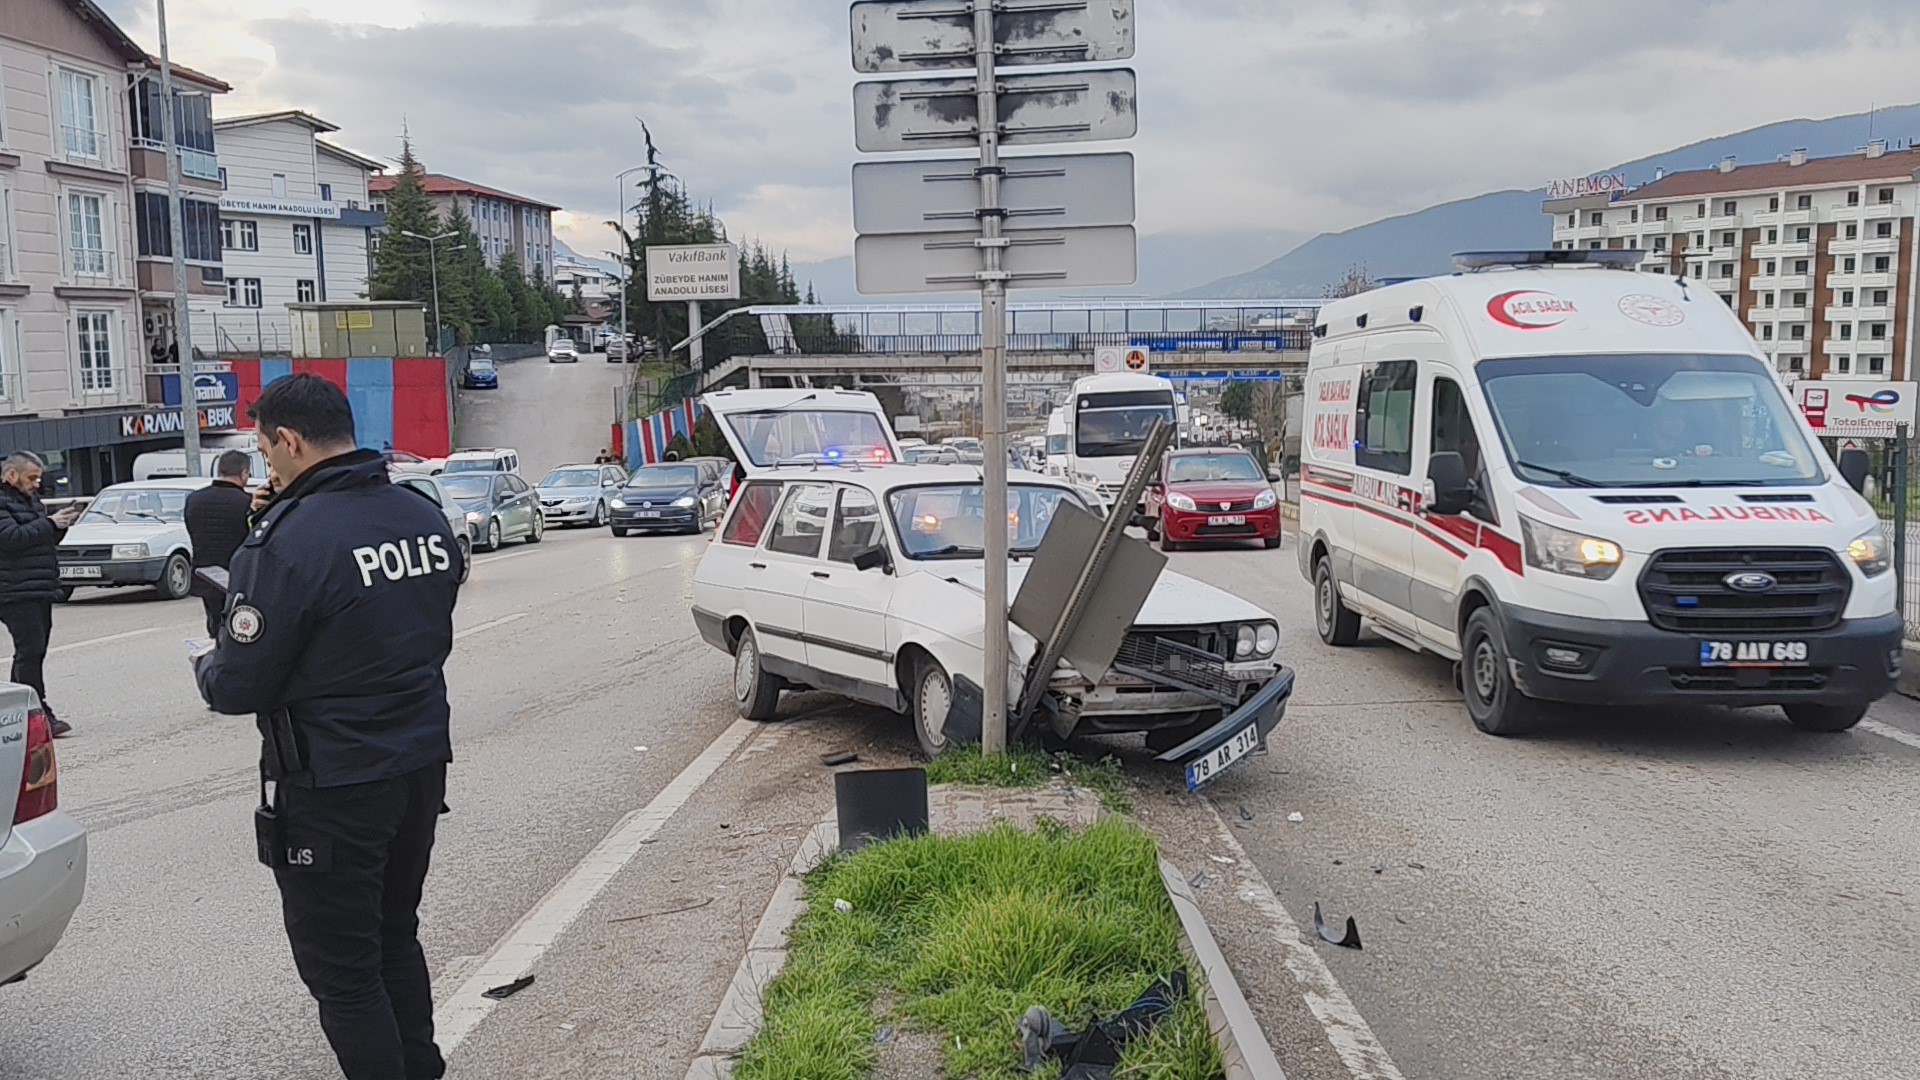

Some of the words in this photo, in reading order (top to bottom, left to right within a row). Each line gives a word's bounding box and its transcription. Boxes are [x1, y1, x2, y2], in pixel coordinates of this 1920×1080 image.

[1550, 173, 1625, 195] ANEMON
[220, 199, 251, 208] ÜBEYDE
[252, 203, 276, 211] HANIM
[278, 204, 311, 213] ANADOLU
[654, 273, 695, 284] ZÜBEYDE
[698, 274, 728, 282] HANIM
[655, 286, 697, 295] ANADOLU
[700, 283, 728, 294] LİSESİ
[1833, 418, 1909, 431] TotalEnergies
[1352, 474, 1400, 508] AMBULANS
[1709, 642, 1733, 660] 78
[1773, 642, 1807, 660] 649
[1194, 759, 1210, 782] 78
[1218, 745, 1231, 768] AR
[1236, 726, 1257, 753] 314
